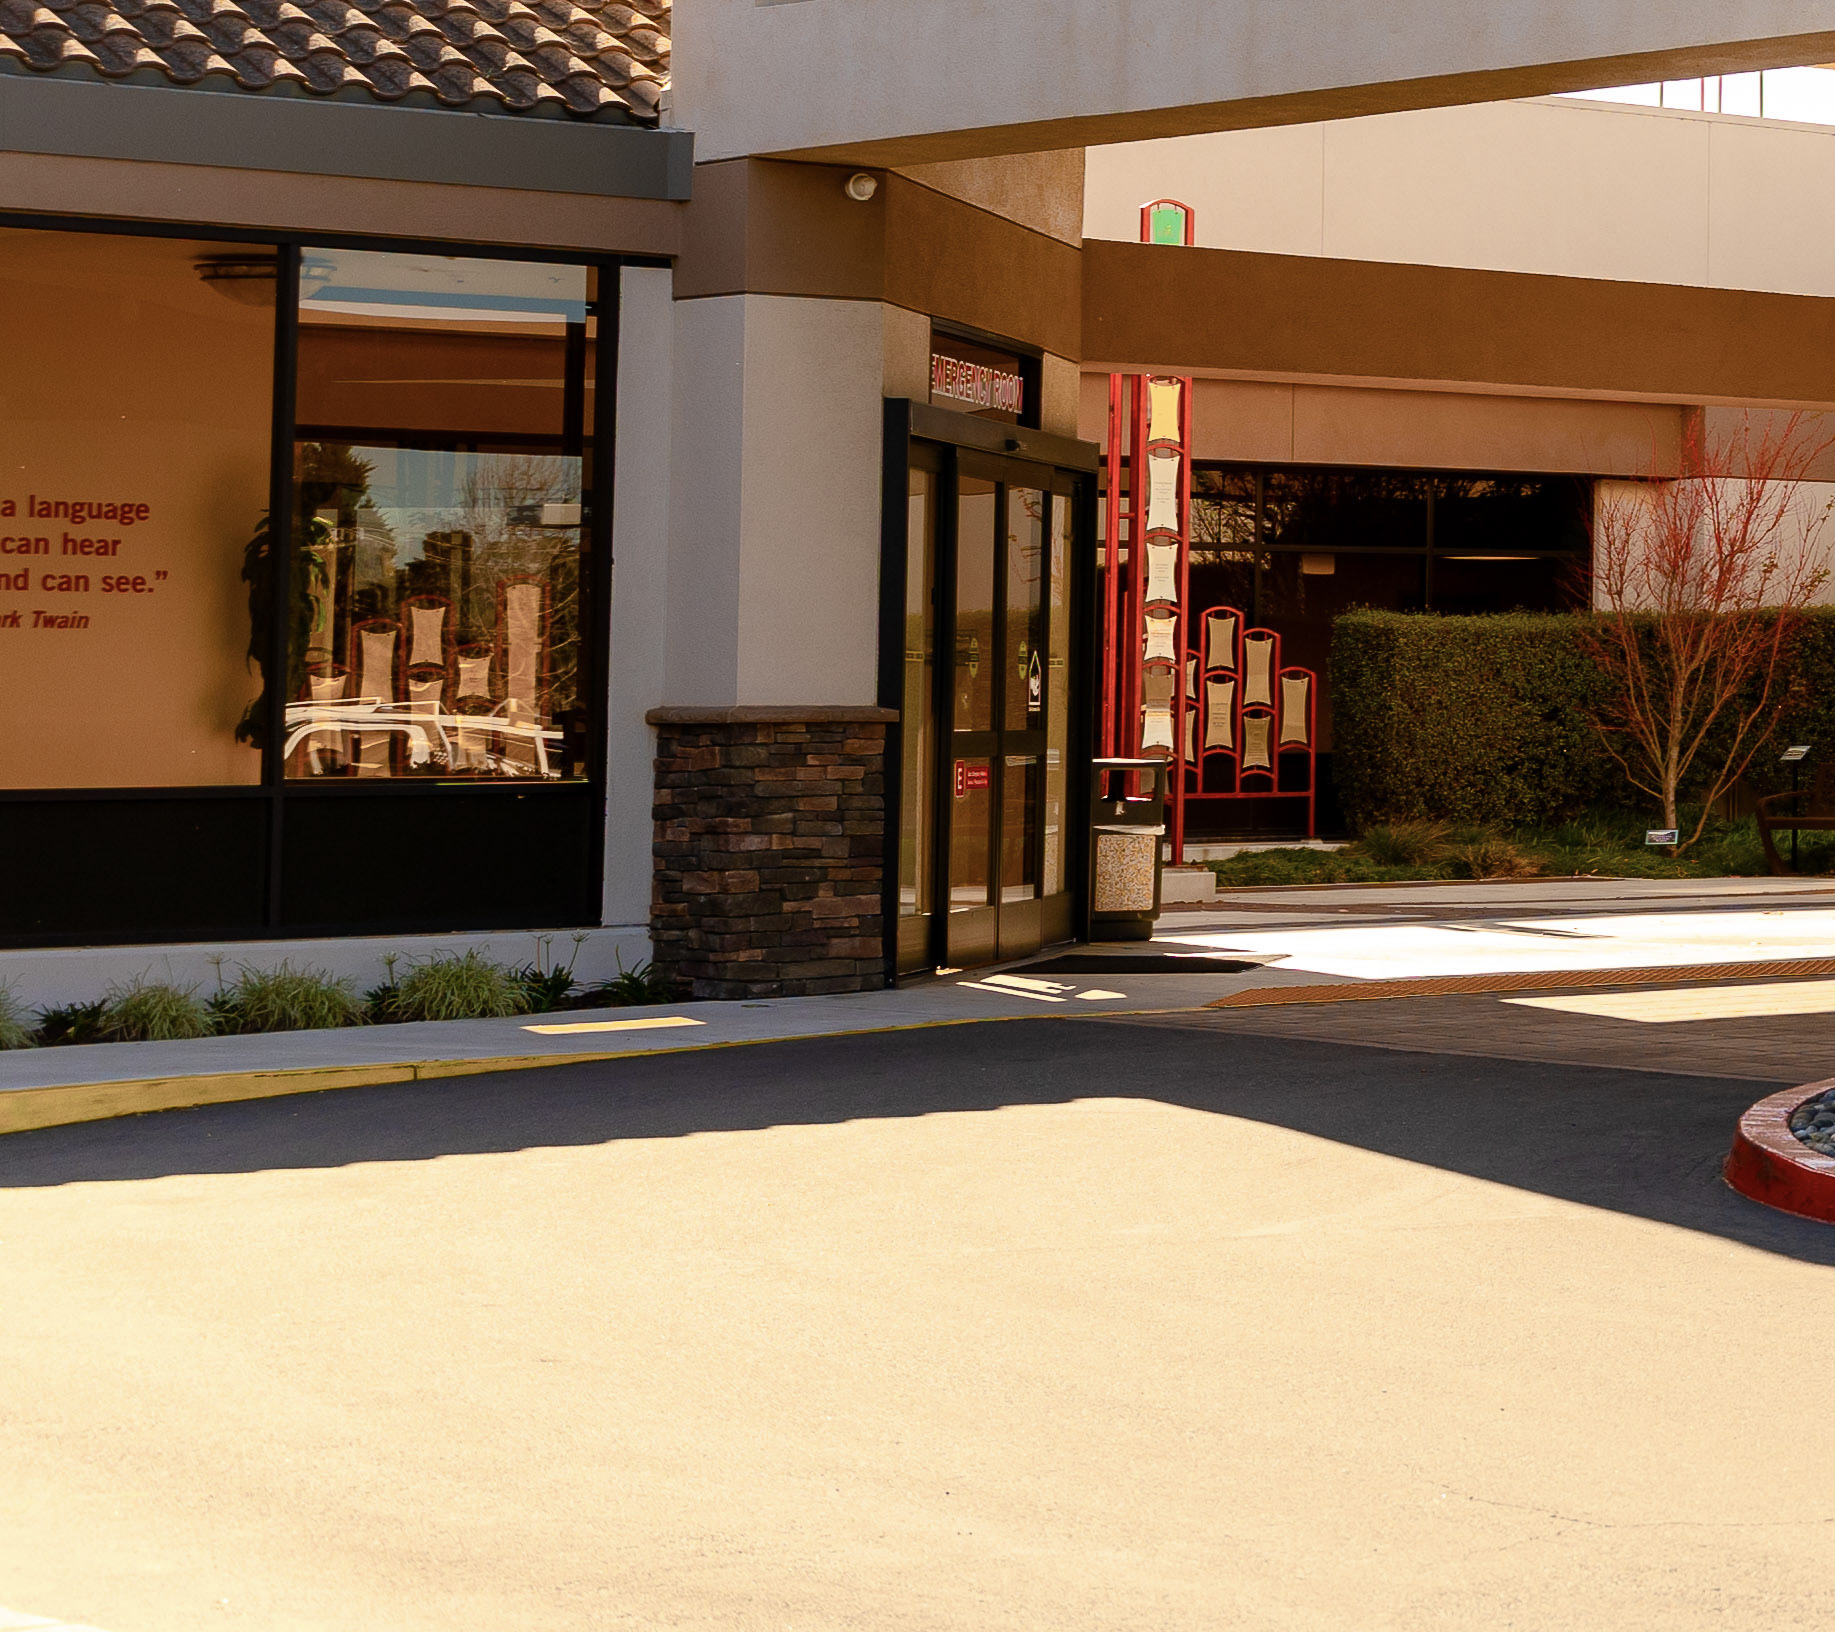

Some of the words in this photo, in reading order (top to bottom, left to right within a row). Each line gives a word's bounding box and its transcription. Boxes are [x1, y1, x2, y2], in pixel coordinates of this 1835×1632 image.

[994, 370, 1023, 414] ROOM
[1, 499, 17, 517] a
[29, 494, 150, 526] language
[1, 536, 50, 555] can
[62, 532, 122, 556] hear
[42, 573, 90, 592] can
[0, 610, 23, 628] rk
[32, 610, 90, 629] Twain
